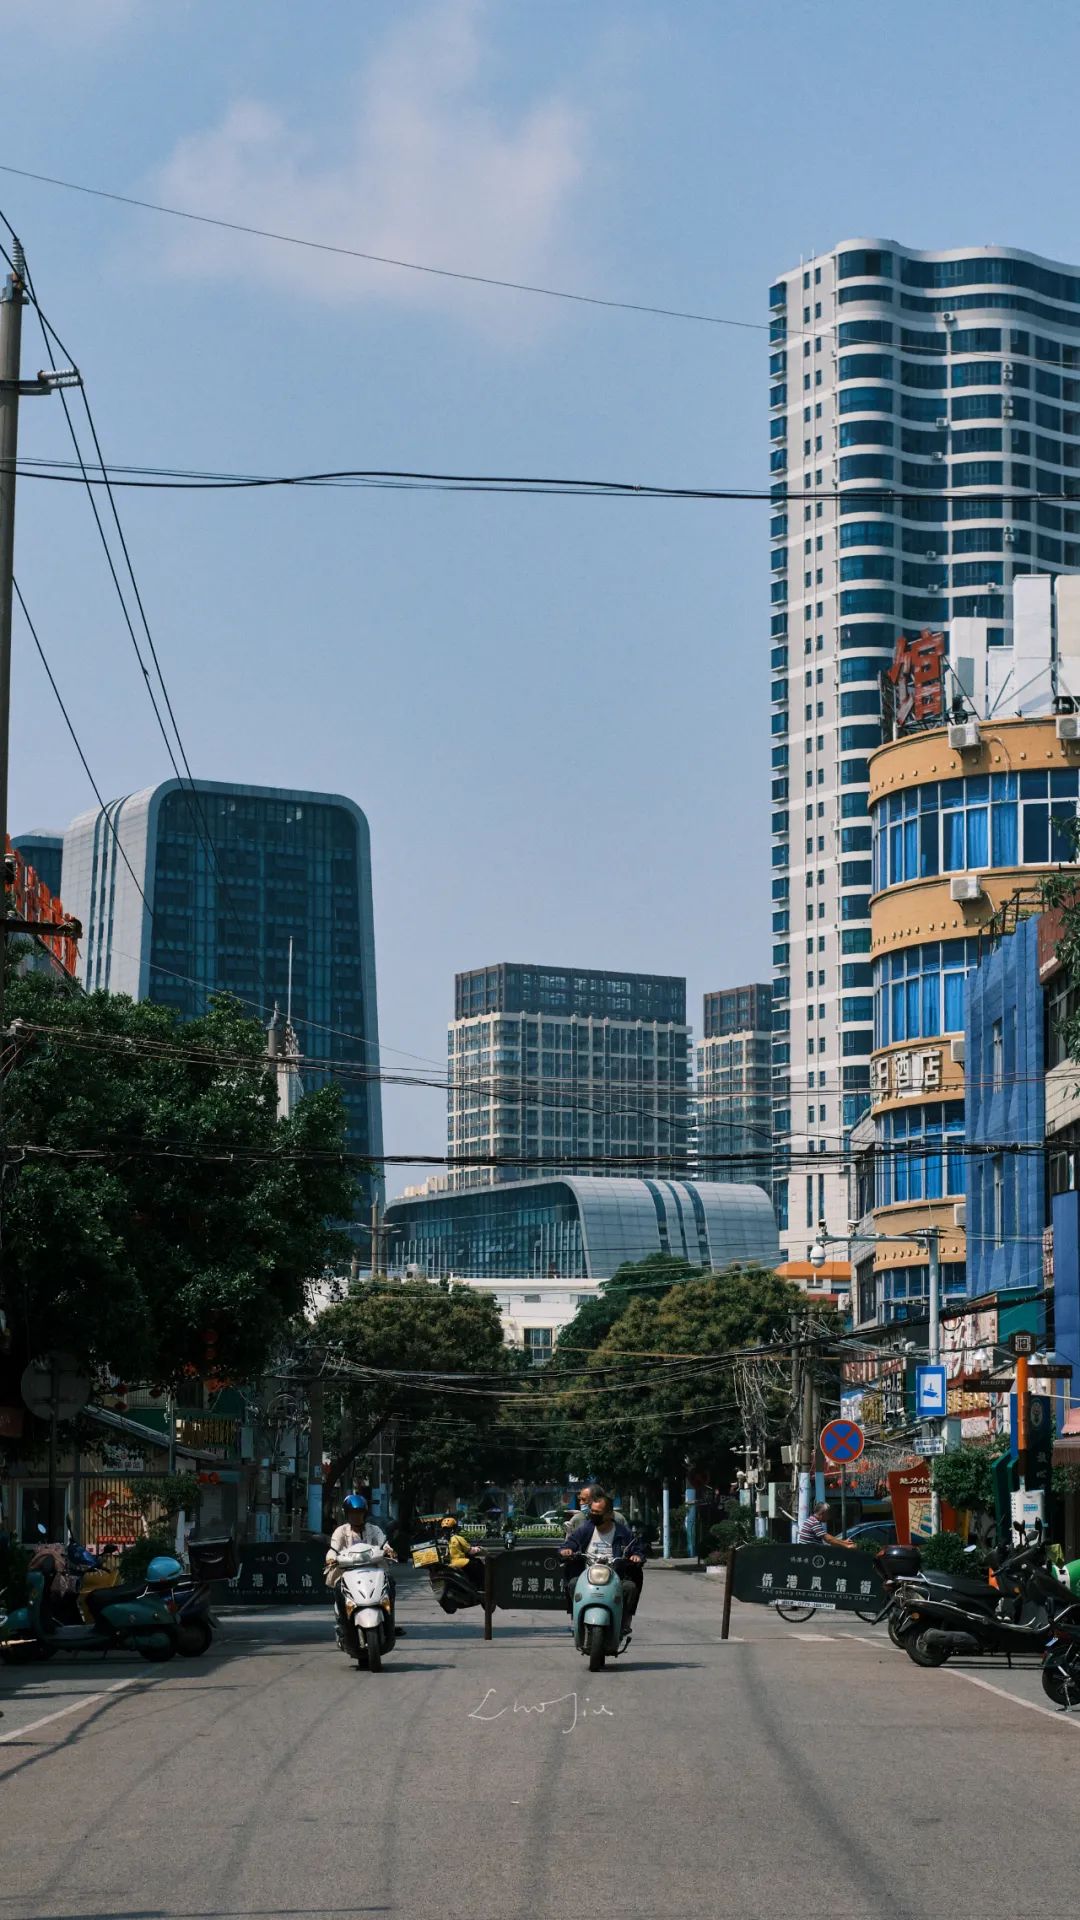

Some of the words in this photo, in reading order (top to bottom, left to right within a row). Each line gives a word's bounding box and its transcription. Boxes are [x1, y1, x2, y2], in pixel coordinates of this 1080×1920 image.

[761, 1573, 872, 1594] 侨港风情街
